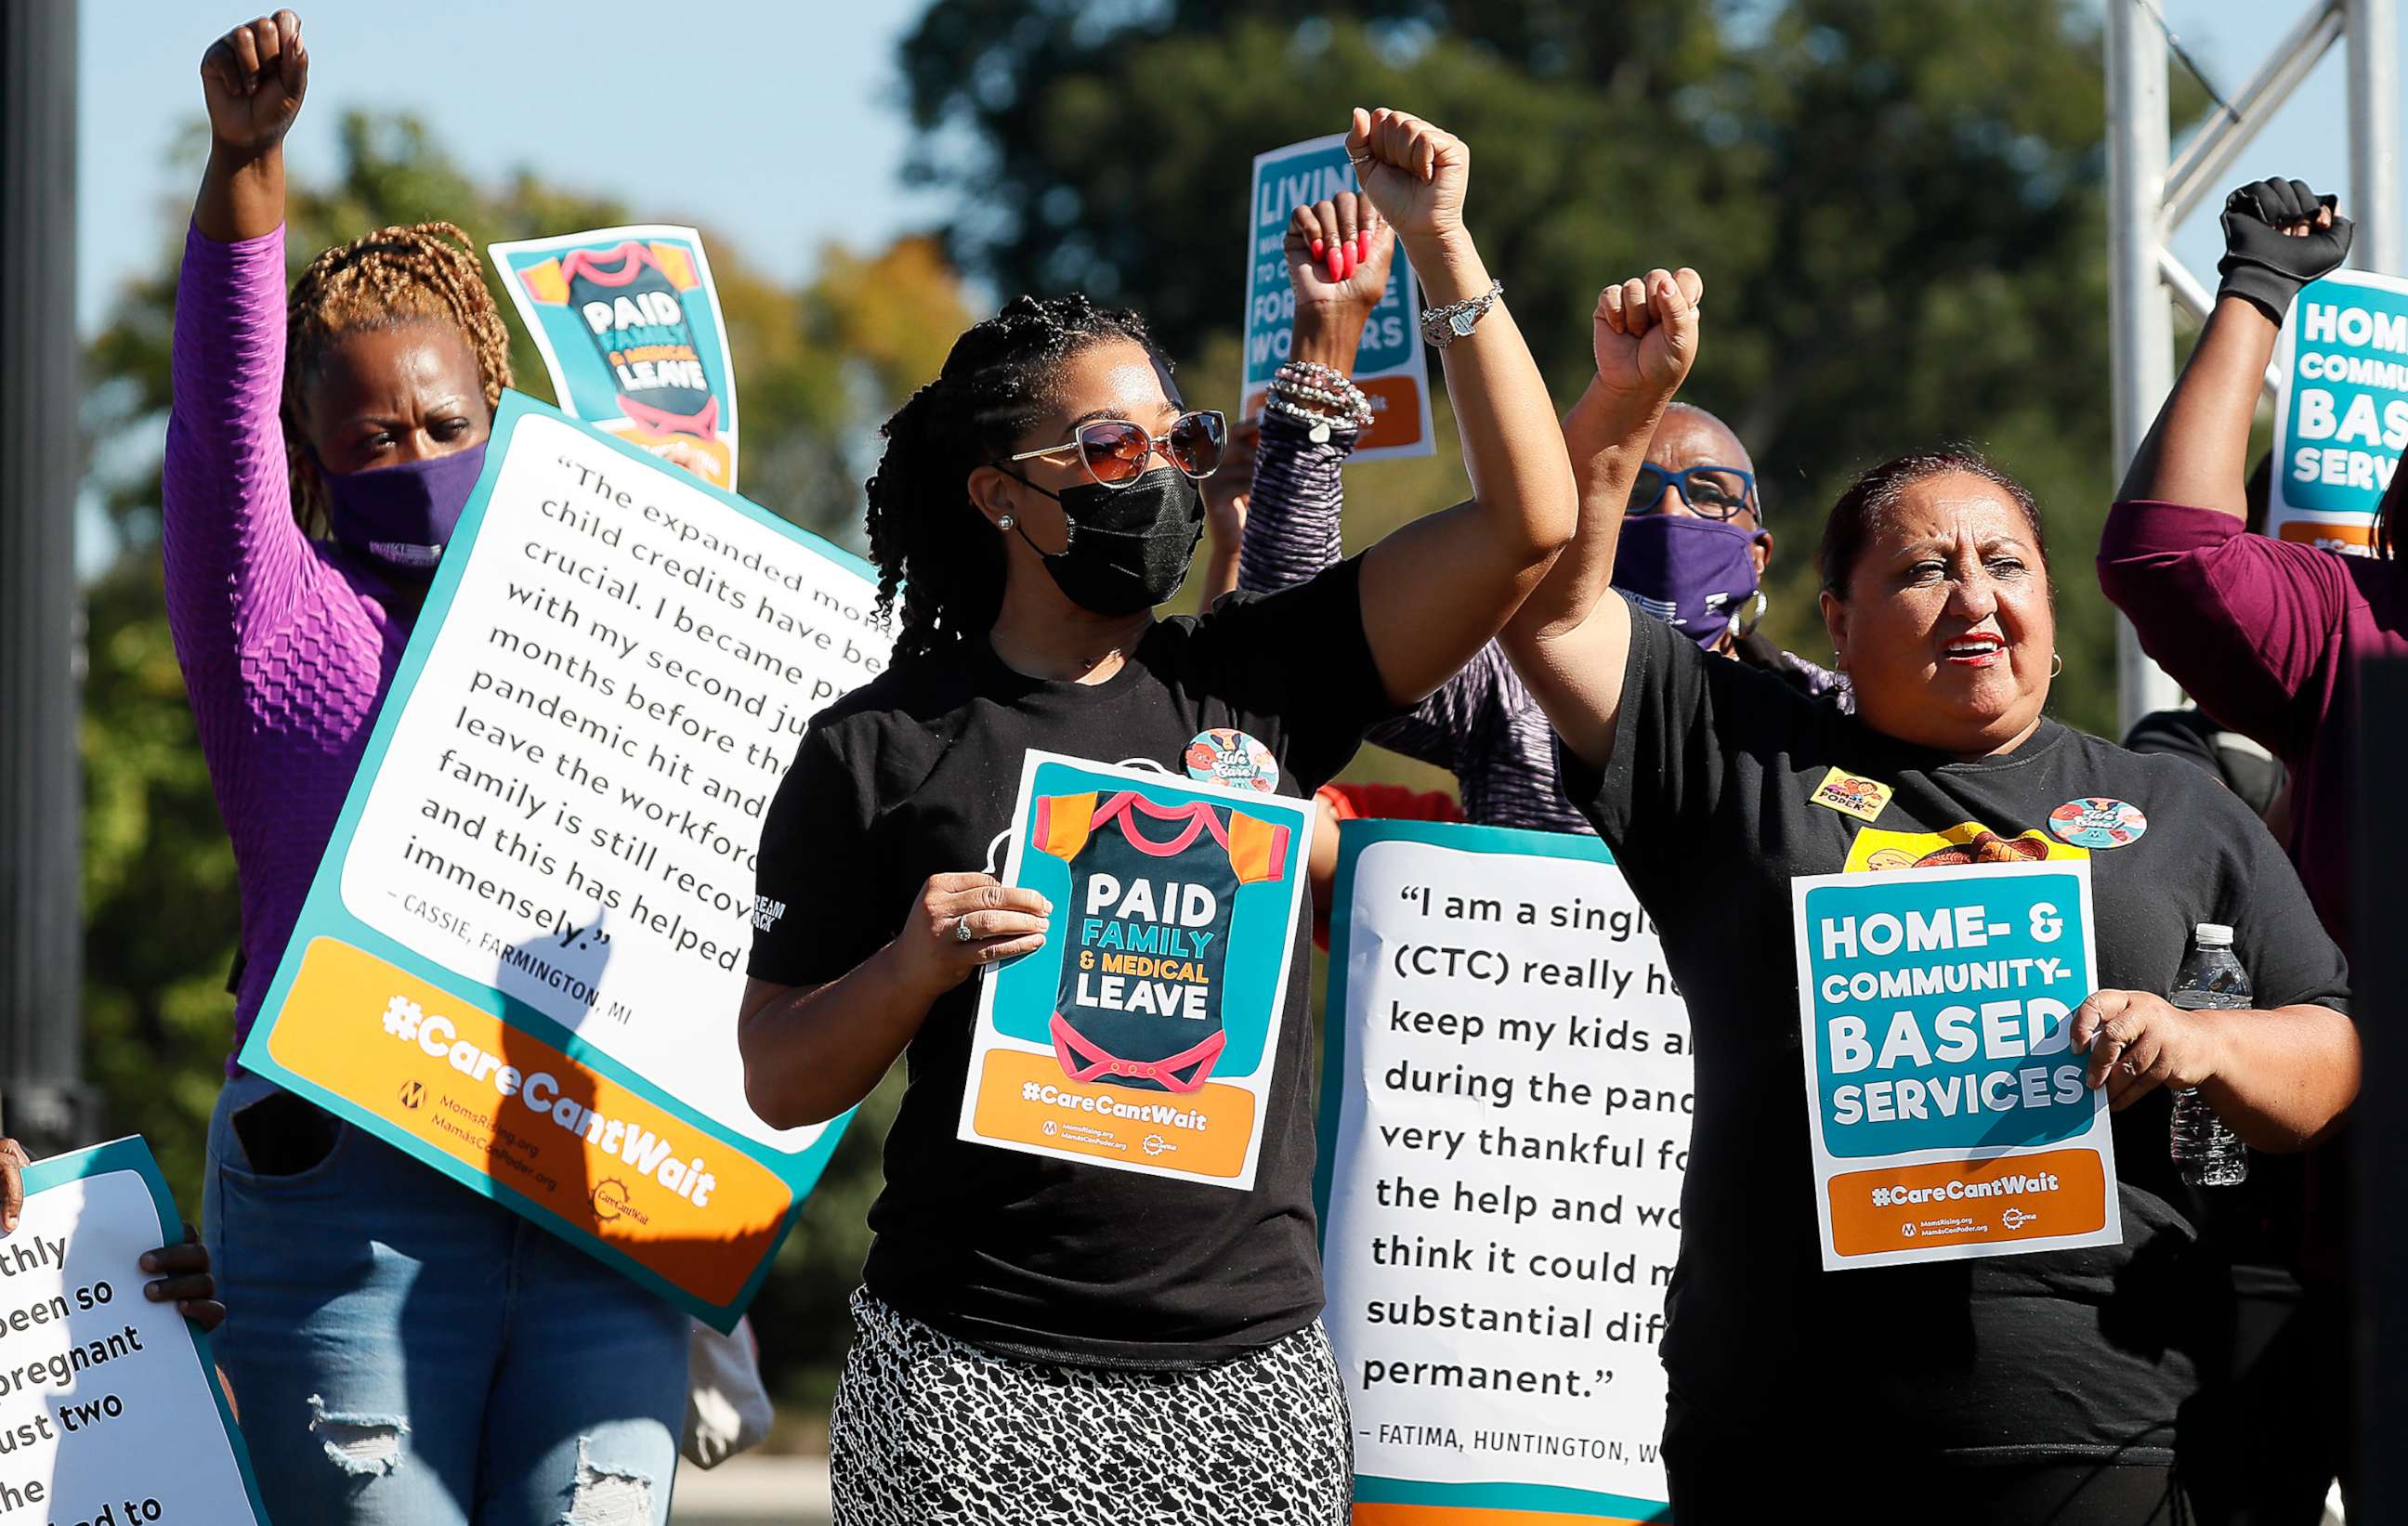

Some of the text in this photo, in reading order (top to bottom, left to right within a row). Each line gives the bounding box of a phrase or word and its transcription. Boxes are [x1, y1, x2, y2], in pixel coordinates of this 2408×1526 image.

[582, 291, 681, 334] PAID
[617, 360, 707, 391] LEAVE
[2297, 388, 2408, 451] BAS
[557, 454, 633, 509] “The
[644, 504, 804, 593] expanded
[542, 498, 622, 548] child
[632, 542, 747, 609] credits
[756, 599, 832, 650] have
[524, 541, 642, 610] crucial.
[654, 597, 667, 620] I
[674, 606, 804, 685] became
[506, 580, 580, 629] with
[589, 618, 639, 660] my
[646, 649, 768, 717] second
[489, 624, 615, 698] months
[625, 683, 736, 754] before
[454, 706, 545, 764] leave
[556, 753, 610, 795] the
[469, 667, 767, 819] pandemic hit and
[439, 749, 547, 820] family
[555, 802, 583, 835] is
[590, 828, 657, 873] still
[1819, 791, 1865, 811] PODER
[402, 834, 611, 953] immensely.”
[420, 798, 742, 972] and this has helped
[1084, 872, 1217, 928] PAID
[1401, 884, 1431, 916] “I
[1445, 896, 1501, 921] am
[1516, 902, 1537, 925] a
[1080, 918, 1216, 959] FAMILY
[1821, 901, 2063, 959] HOME- &
[403, 893, 473, 944] CASSIE,
[479, 932, 601, 1013] FARMINGTON,
[607, 999, 634, 1025] MI
[1079, 949, 1211, 984] & MEDICAL
[1394, 943, 1510, 986] (CTC)
[1524, 958, 1633, 999] really
[1821, 957, 2071, 1003] COMMUNITY-
[1074, 972, 1209, 1021] LEAVE
[1390, 1000, 1694, 1056] keep my kids a
[1827, 997, 2073, 1075] BASED
[381, 995, 717, 1208] #CareCantWait
[1021, 1081, 1208, 1131] #CareCantWait
[1384, 1060, 1514, 1109] during
[1529, 1073, 1592, 1106] the
[1832, 1065, 2084, 1127] SERVICES
[439, 1094, 539, 1160] MomsRising.org
[1380, 1125, 1466, 1160] very
[1478, 1127, 1644, 1168] thankful
[1376, 1178, 1440, 1209] the
[1453, 1181, 1538, 1224] help
[1551, 1195, 1623, 1226] and
[1871, 1171, 2060, 1207] #CareCantWait
[1920, 1217, 1973, 1228] MomsRising.org
[1371, 1235, 1473, 1272] think
[1487, 1242, 1516, 1274] it
[1528, 1253, 1636, 1285] could
[75, 1281, 113, 1311] so
[1366, 1295, 1592, 1339] substantial
[1362, 1358, 1614, 1400] permanent.”
[0, 1394, 123, 1454] ust two
[1379, 1424, 1465, 1453] FATIMA,
[1473, 1429, 1629, 1465] HUNTINGTON,
[0, 1480, 45, 1515] he
[124, 1498, 163, 1526] to
